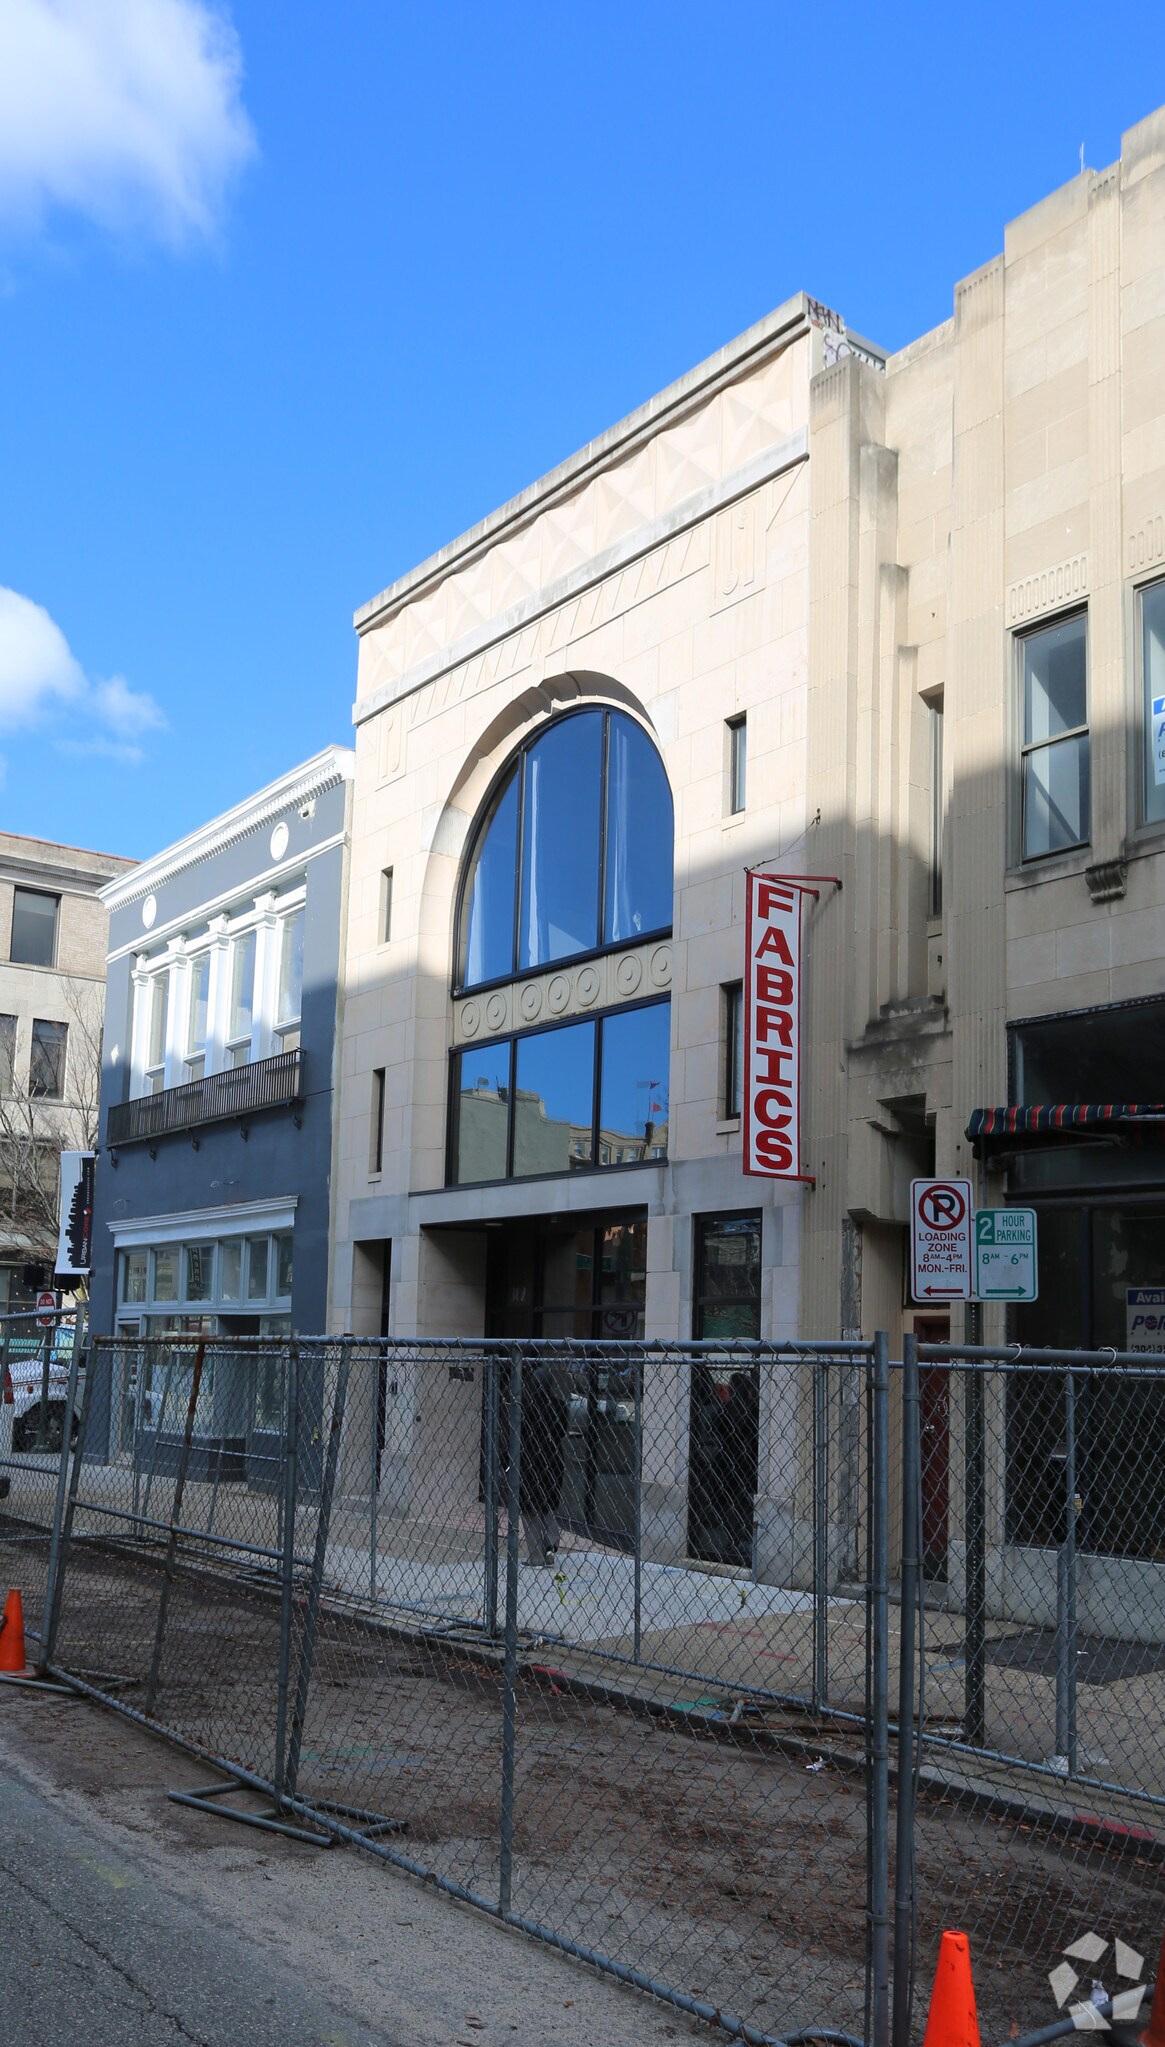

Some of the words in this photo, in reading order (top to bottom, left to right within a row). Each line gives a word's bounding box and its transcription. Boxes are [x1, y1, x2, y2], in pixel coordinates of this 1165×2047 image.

[754, 883, 795, 1170] FABRICS
[1002, 1215, 1025, 1227] HOUR
[979, 1216, 993, 1240] 2
[918, 1232, 966, 1241] LOADING
[996, 1229, 1031, 1241] PARKING
[927, 1243, 957, 1252] ZONE
